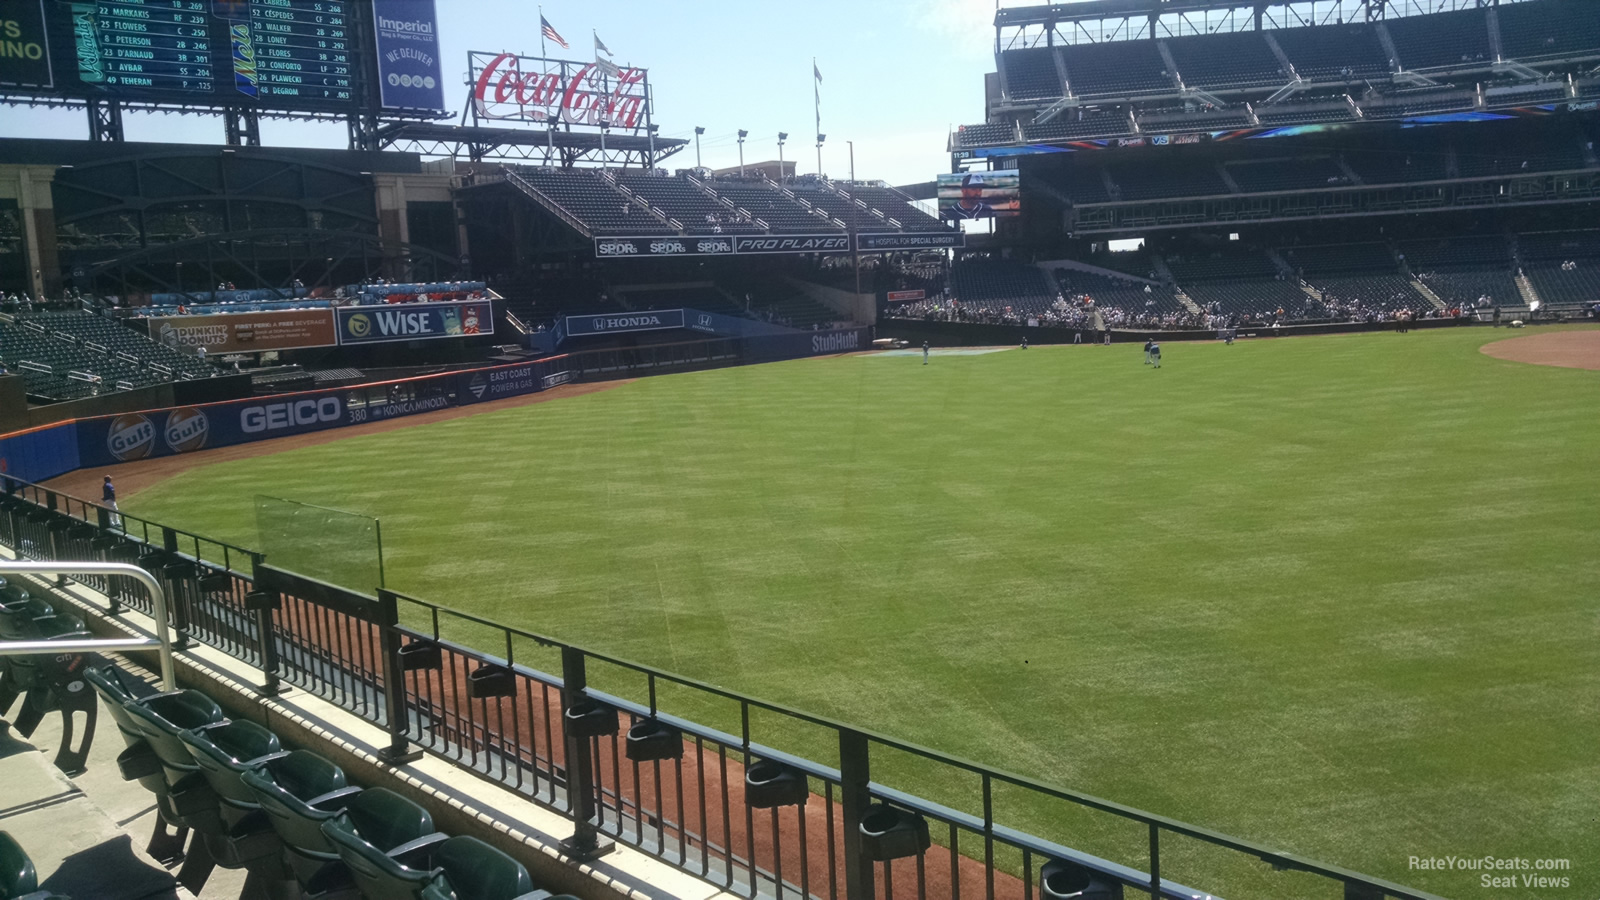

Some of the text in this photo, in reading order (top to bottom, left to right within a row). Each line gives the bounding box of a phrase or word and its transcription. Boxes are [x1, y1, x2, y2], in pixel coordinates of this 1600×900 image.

[113, 8, 150, 18] MARKAKIS
[190, 16, 204, 24] .239
[115, 21, 147, 31] FLOWERS
[266, 23, 291, 32] WALKER
[378, 16, 432, 33] Imperial
[116, 36, 151, 45] PETERSON
[268, 36, 287, 44] LONEY
[118, 50, 154, 59] D'ARNAUD
[269, 49, 291, 57] FLORES
[386, 48, 433, 67] WE DELIVER
[119, 64, 143, 72] AYBAR
[270, 62, 301, 70] CONFORTO
[120, 77, 152, 86] TEHERAN
[271, 74, 302, 83] PLAWECKI
[273, 87, 298, 95] DEGROM
[1152, 137, 1168, 145] VS
[738, 238, 848, 249] PRO PLAYER
[236, 293, 249, 301] citi
[376, 311, 431, 335] WISE
[607, 316, 661, 328] HONDA
[179, 325, 227, 337] DUNKIN'
[179, 335, 227, 346] DONUTS
[812, 331, 858, 352] StubHub!
[490, 368, 531, 382] EAST COAST
[491, 382, 515, 393] POWER
[520, 380, 533, 388] GAS
[383, 397, 448, 416] KONICA MINOLTA
[240, 397, 341, 432] GEICO
[349, 409, 366, 422] 380
[168, 417, 205, 442] Gulf
[110, 424, 151, 451] Gulf
